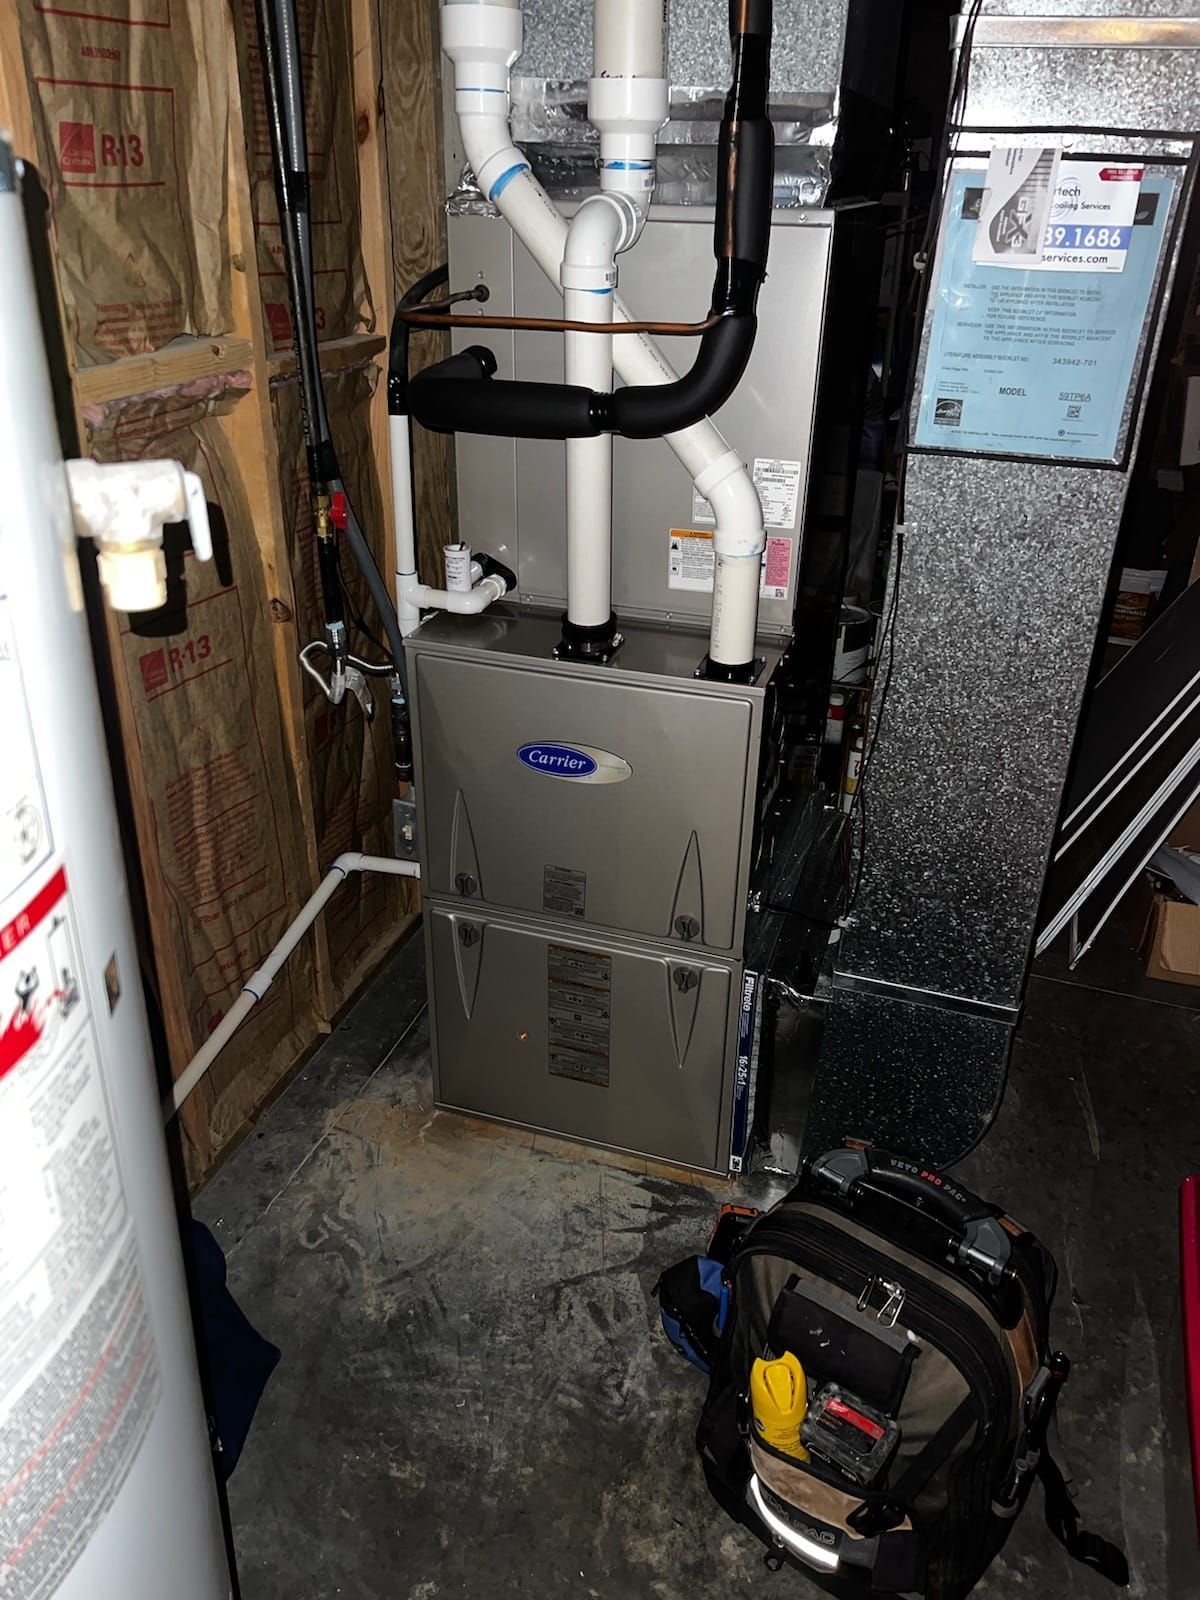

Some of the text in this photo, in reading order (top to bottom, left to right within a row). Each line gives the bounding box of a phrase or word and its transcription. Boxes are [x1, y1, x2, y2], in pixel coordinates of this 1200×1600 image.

[1050, 200, 1111, 210] ooling Services
[1044, 227, 1121, 247] 39.1686
[1052, 357, 1097, 367] 343942-701
[999, 387, 1092, 401] MODEL 59TP6A
[528, 750, 587, 770] Carrier
[0, 914, 31, 950] ER
[737, 1055, 749, 1086] 16x25x1
[890, 1158, 964, 1201] VETO PRO PAC
